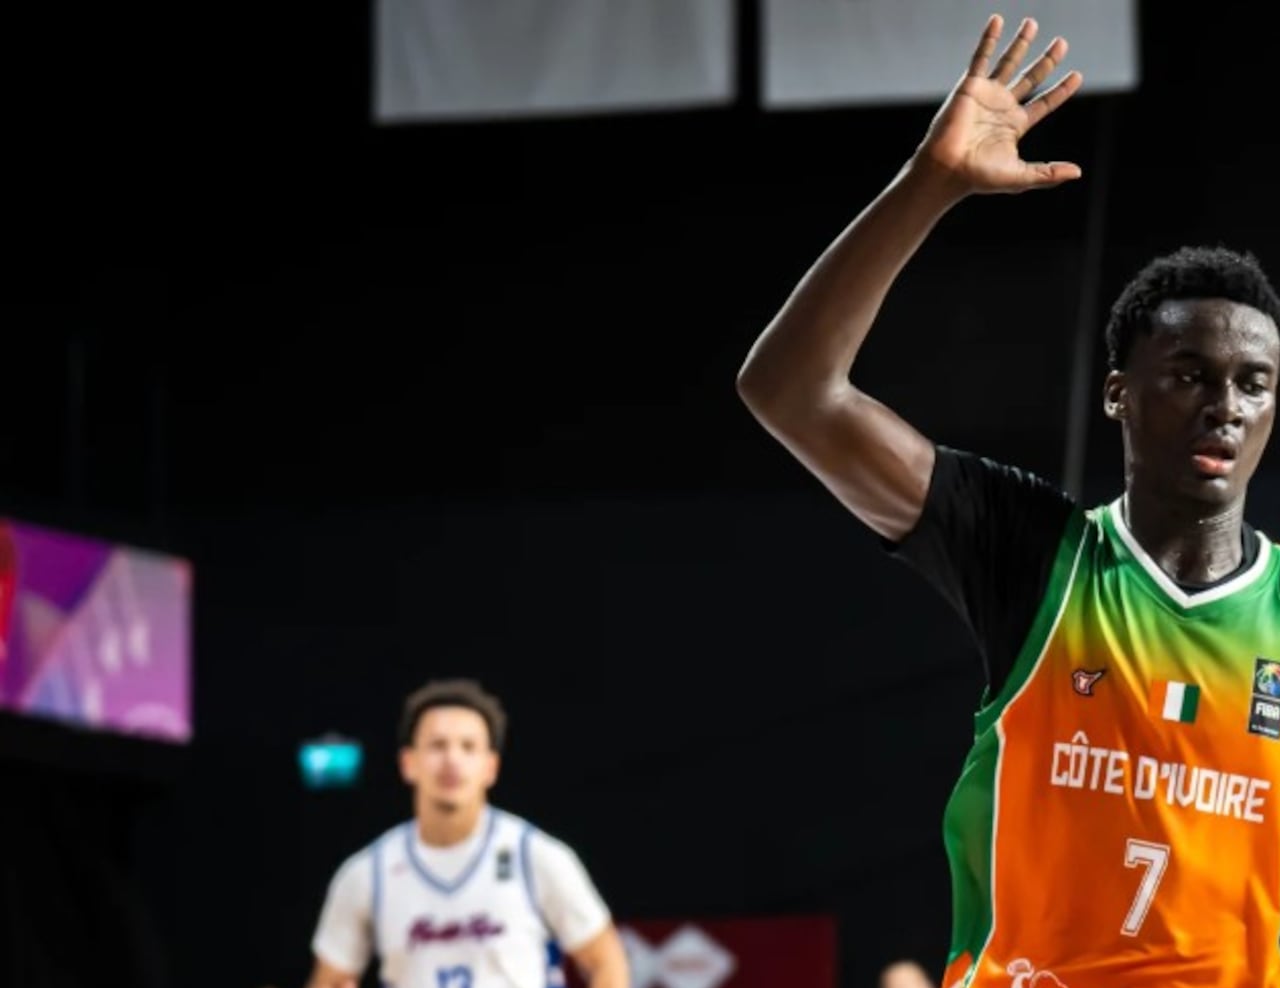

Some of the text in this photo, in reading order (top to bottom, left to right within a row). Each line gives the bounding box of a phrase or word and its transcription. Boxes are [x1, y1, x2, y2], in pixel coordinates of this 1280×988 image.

[1051, 731, 1271, 823] CÔTE D'IVOIRE
[1120, 838, 1171, 937] 7
